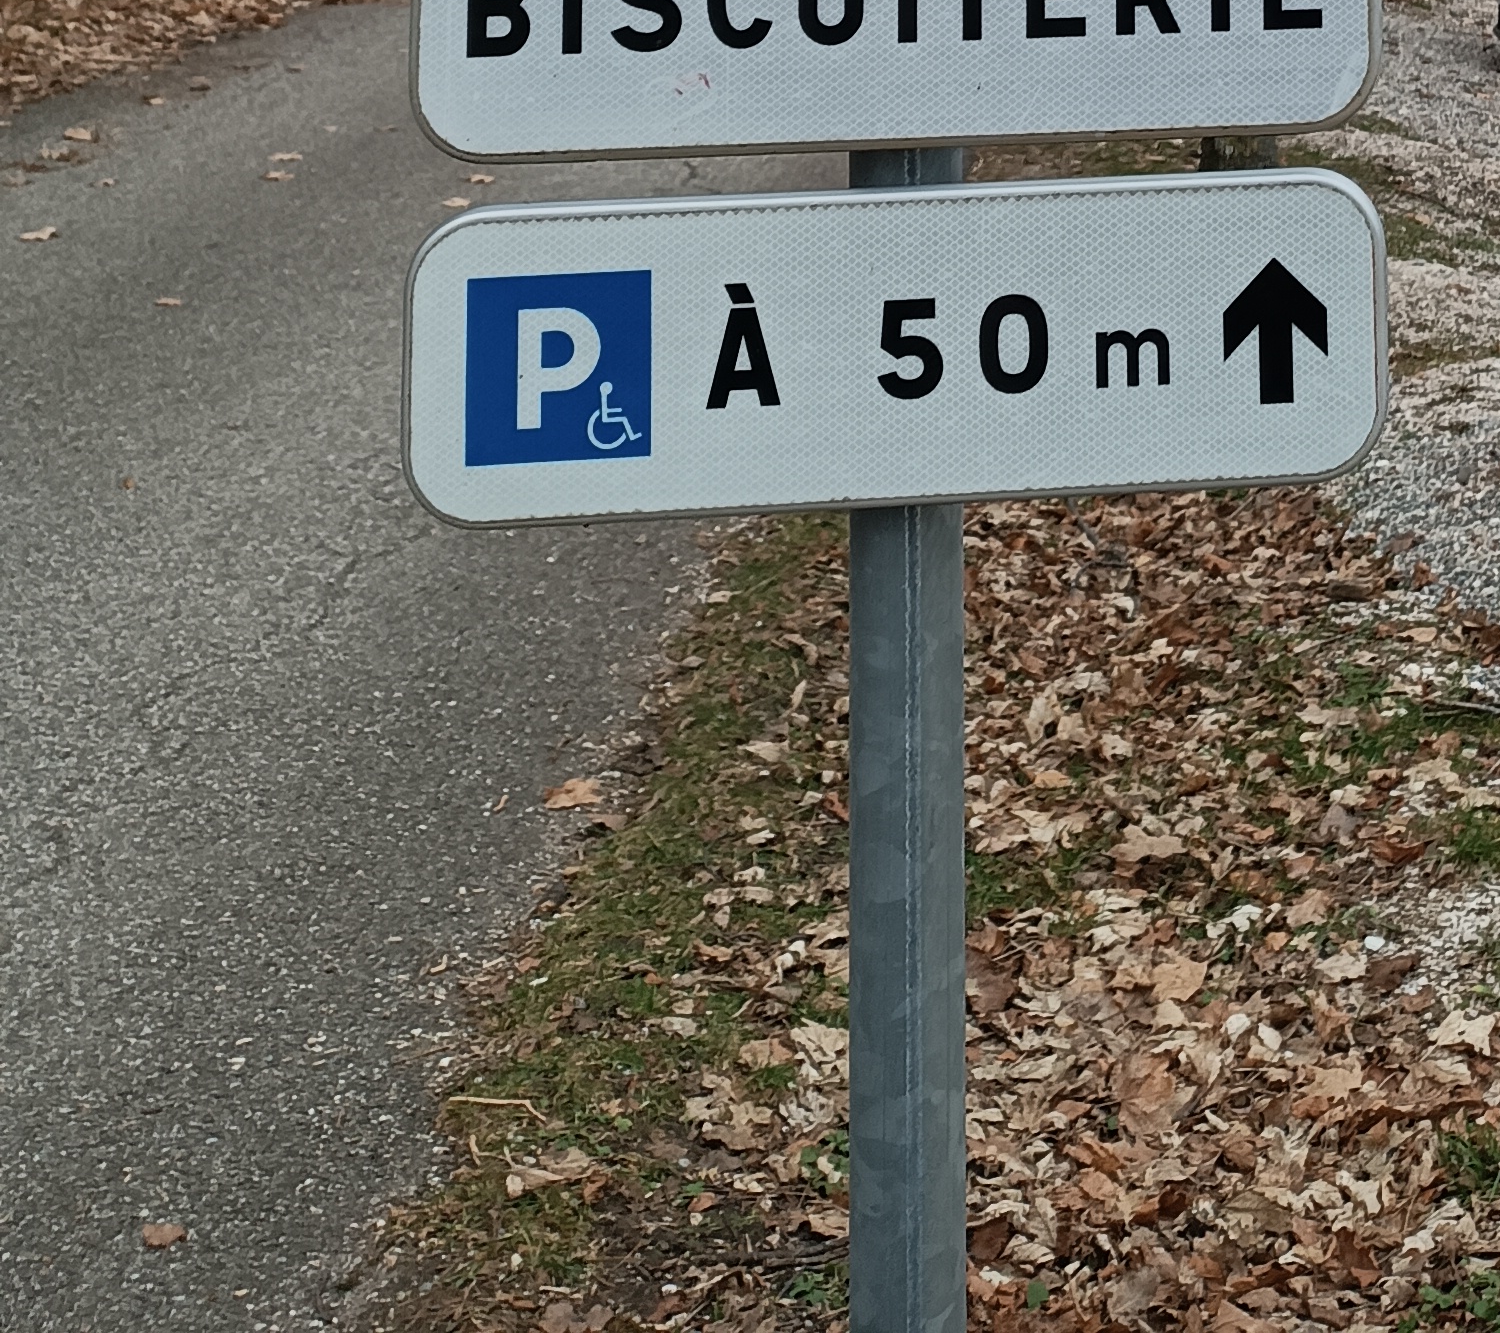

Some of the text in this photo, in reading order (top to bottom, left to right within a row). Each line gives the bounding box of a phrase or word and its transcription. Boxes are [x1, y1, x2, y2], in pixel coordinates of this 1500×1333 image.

[516, 282, 1171, 431] P À 50 m
